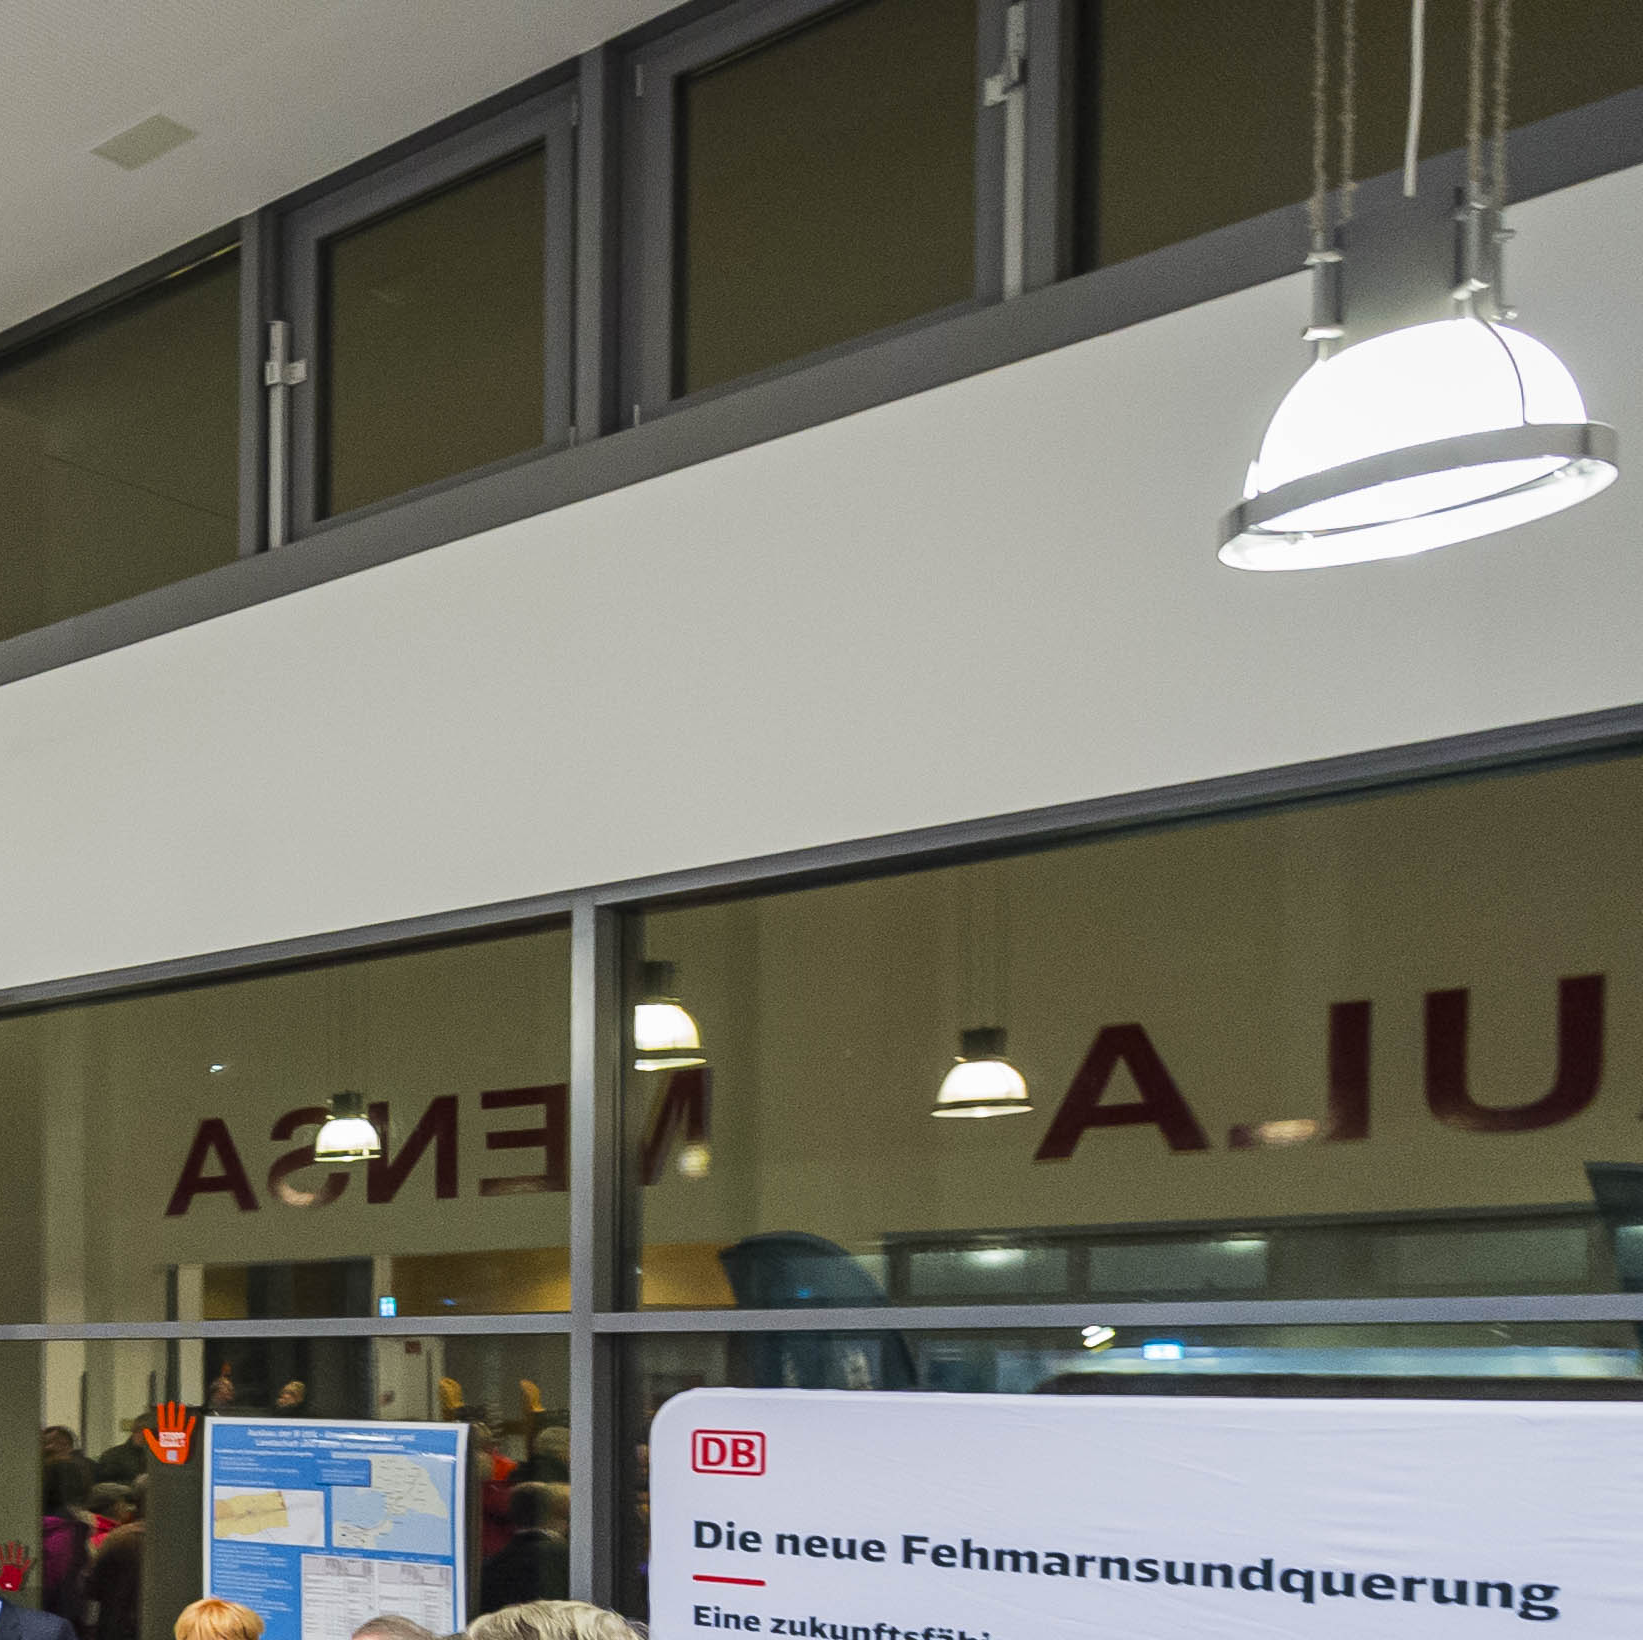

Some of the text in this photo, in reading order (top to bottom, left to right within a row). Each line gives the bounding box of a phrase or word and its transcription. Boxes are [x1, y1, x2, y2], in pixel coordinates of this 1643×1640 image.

[698, 1435, 759, 1470] DB
[693, 1520, 1561, 1621] Die neue Fehmarnsundquerung
[693, 1605, 762, 1633] Eine
